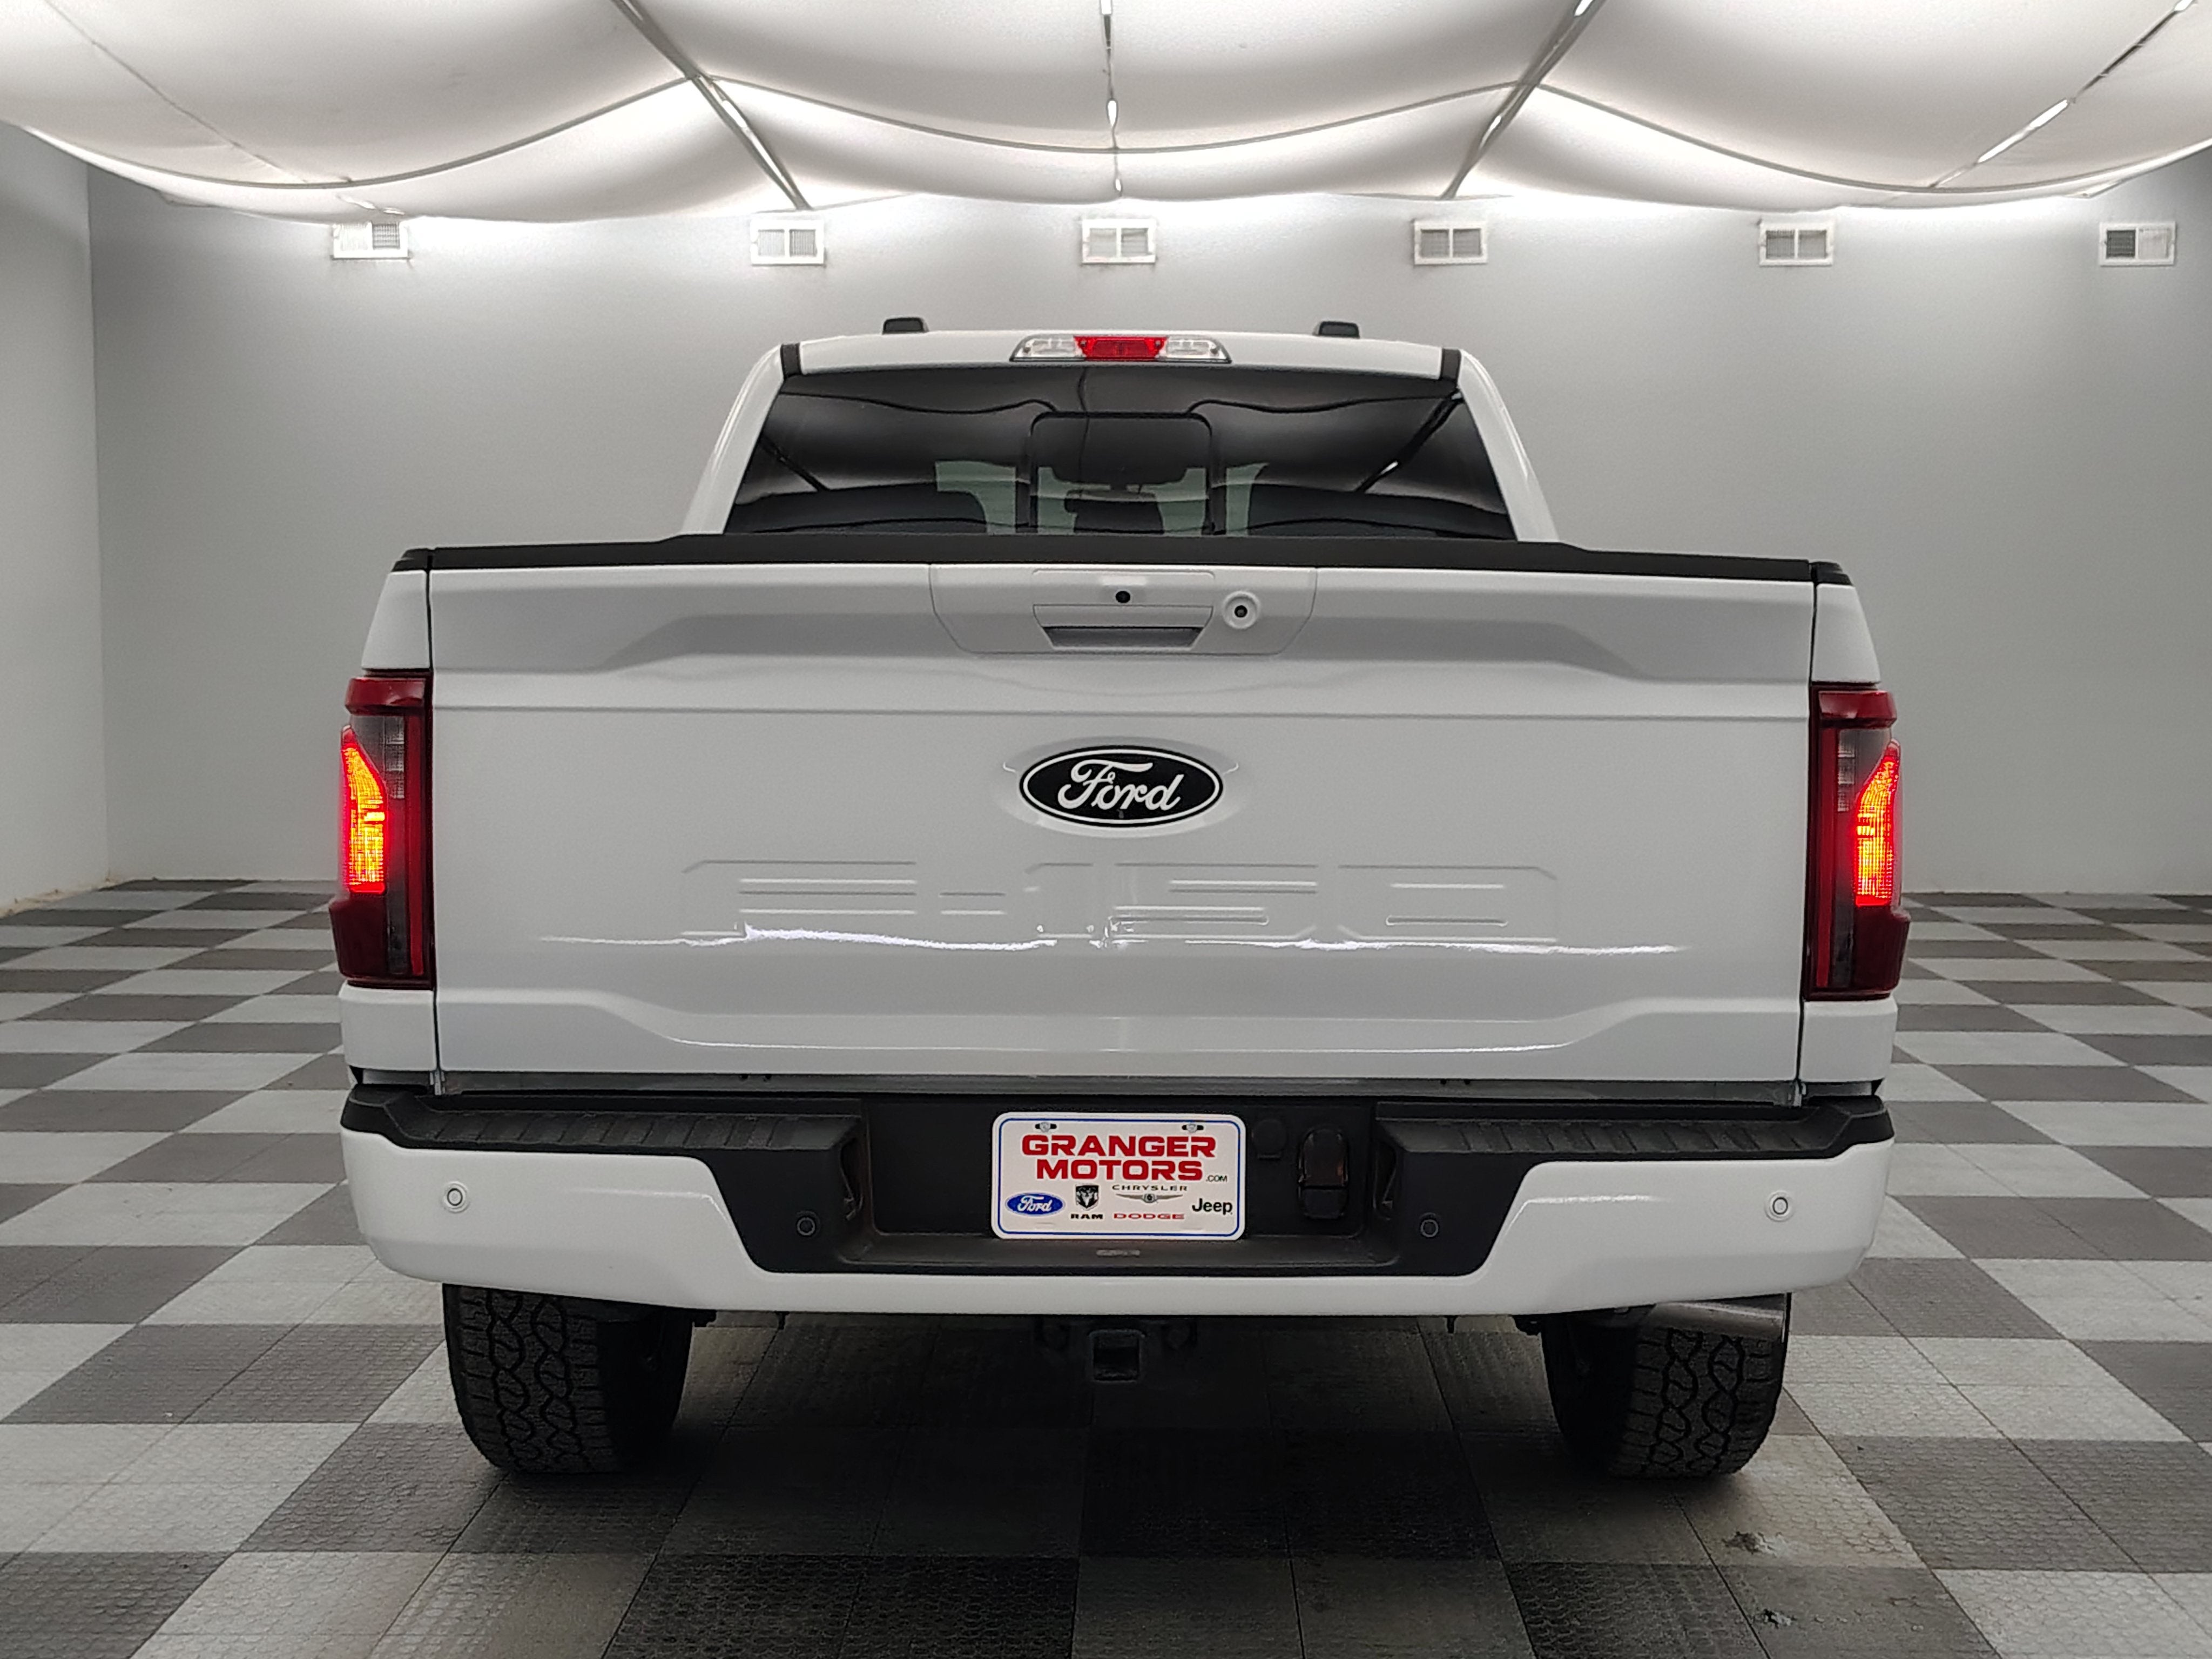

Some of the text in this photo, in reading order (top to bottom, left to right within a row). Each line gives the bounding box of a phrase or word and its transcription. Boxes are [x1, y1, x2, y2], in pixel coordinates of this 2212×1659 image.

[1057, 759, 1184, 811] Ford
[1022, 1135, 1216, 1158] GRANGER
[1037, 1159, 1203, 1181] MOTORS
[1017, 1196, 1053, 1212] Ford
[1191, 1198, 1233, 1215] Jeep
